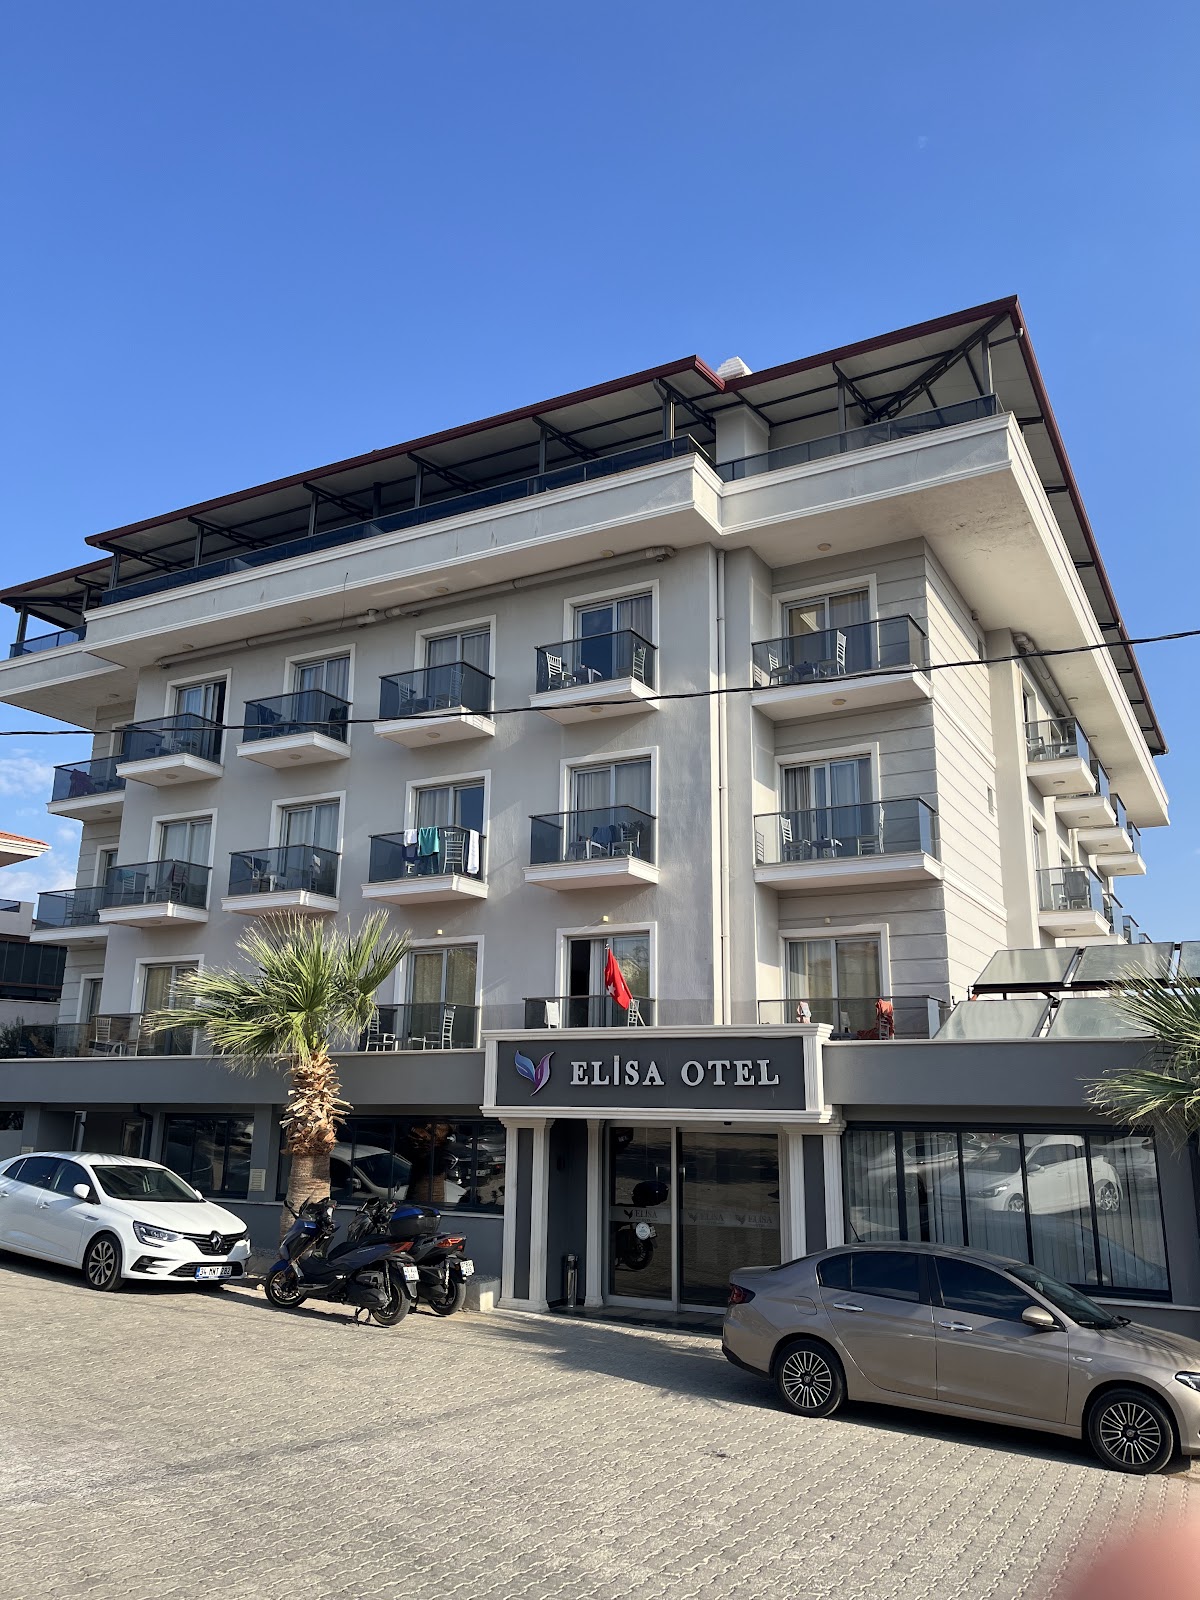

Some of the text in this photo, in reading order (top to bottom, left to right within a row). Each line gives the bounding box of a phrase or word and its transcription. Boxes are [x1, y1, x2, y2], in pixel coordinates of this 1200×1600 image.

[570, 1055, 780, 1087] ELİSA OTEL
[199, 1268, 207, 1276] 34
